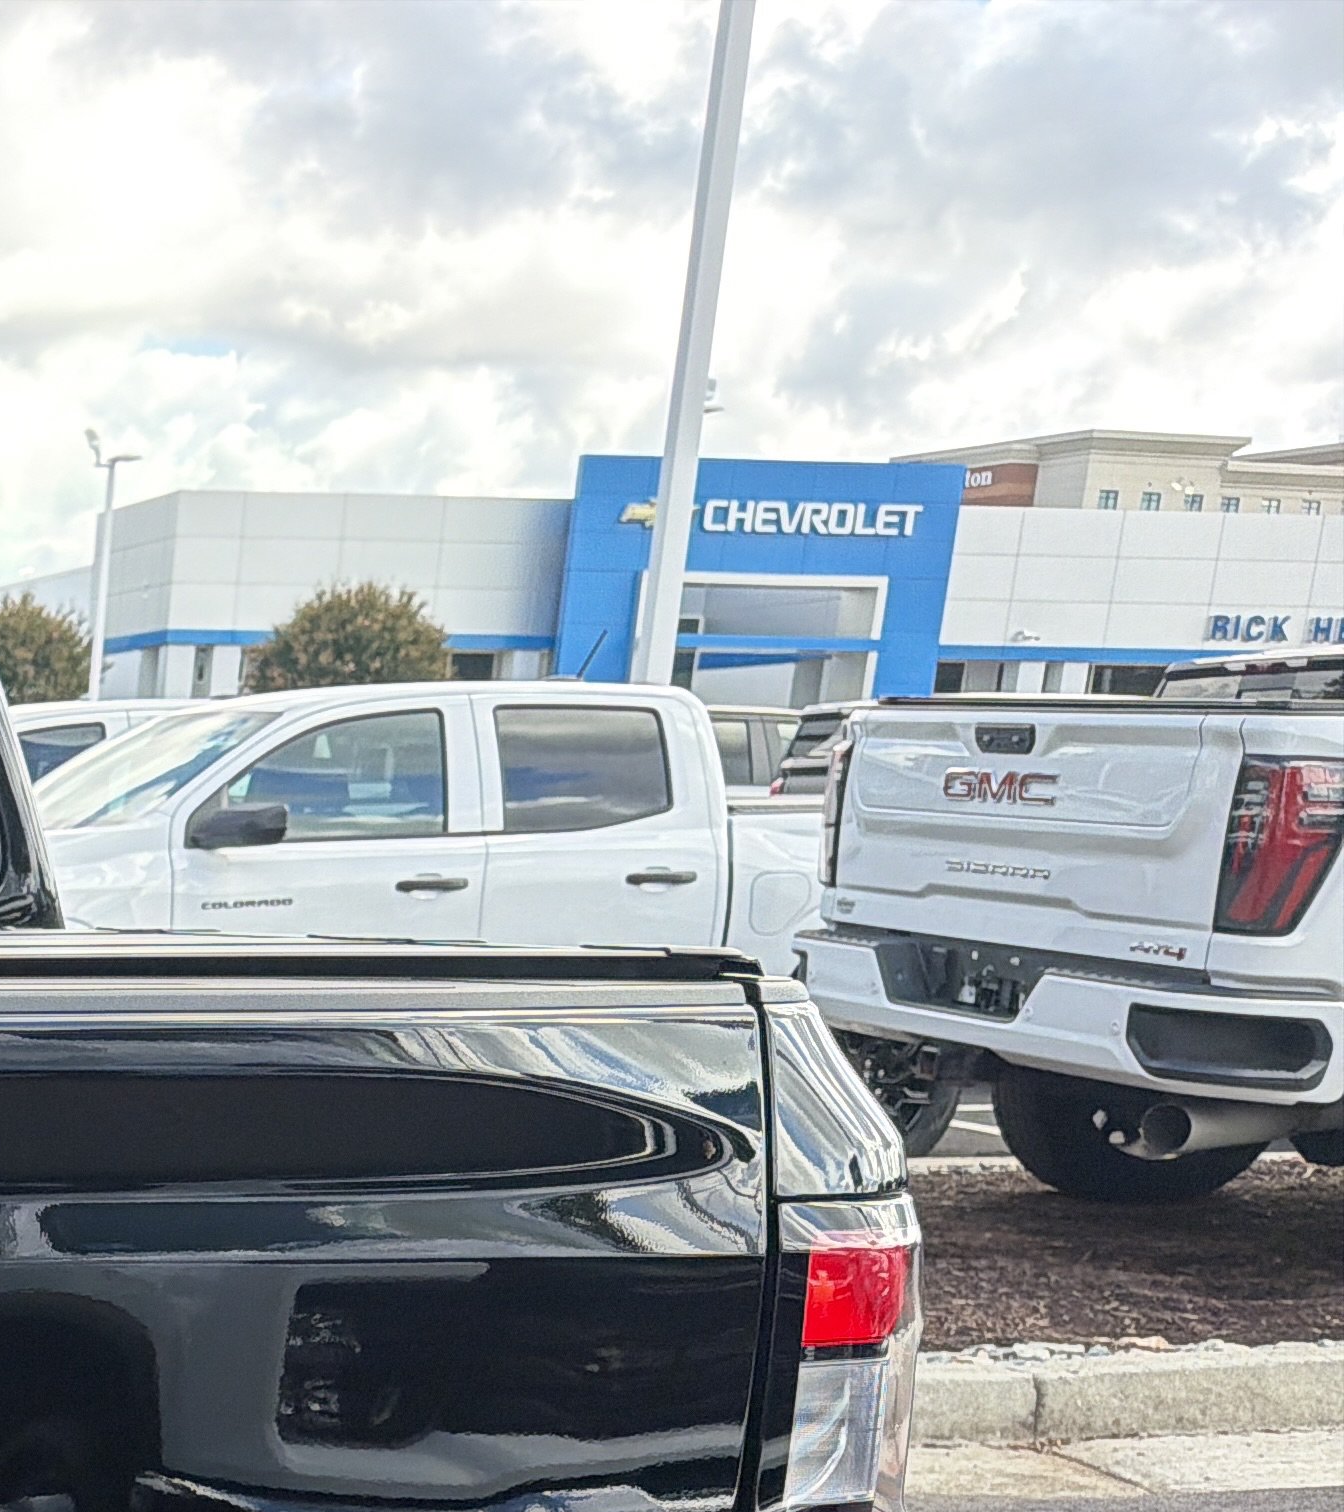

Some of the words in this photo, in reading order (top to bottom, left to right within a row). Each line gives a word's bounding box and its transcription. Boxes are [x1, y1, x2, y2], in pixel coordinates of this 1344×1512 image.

[703, 499, 924, 536] CHEVROLET
[1206, 614, 1292, 642] RICK
[943, 767, 1060, 807] GMC
[945, 857, 1051, 881] SIERRA
[201, 898, 293, 910] COLORADO
